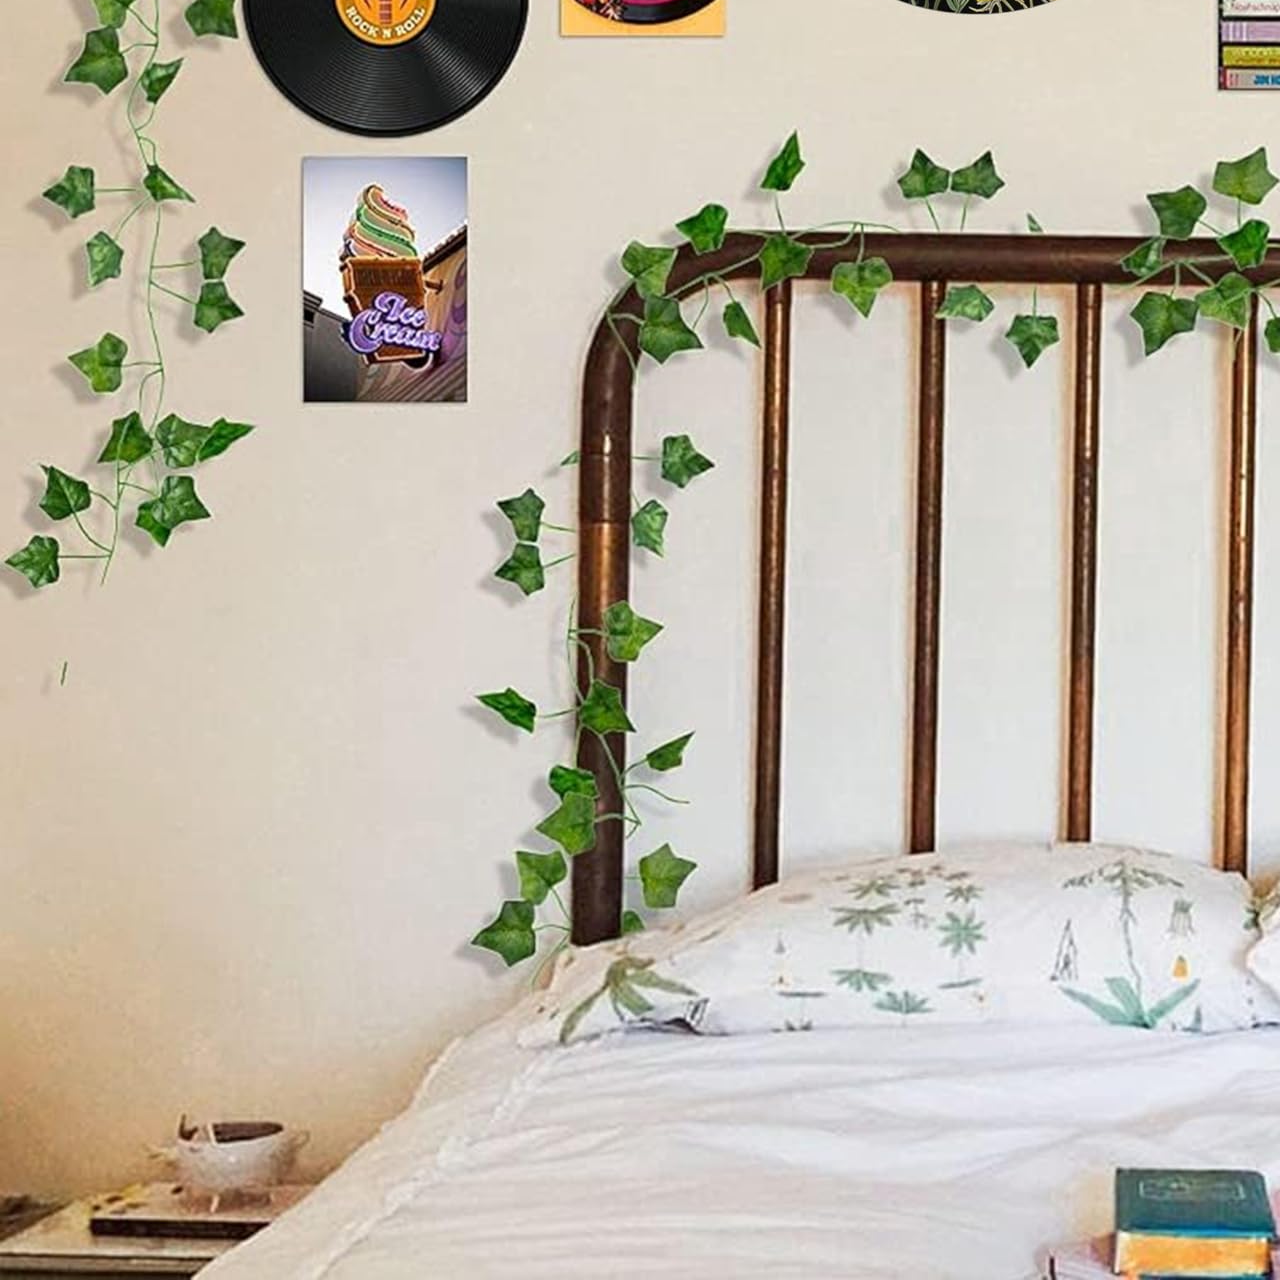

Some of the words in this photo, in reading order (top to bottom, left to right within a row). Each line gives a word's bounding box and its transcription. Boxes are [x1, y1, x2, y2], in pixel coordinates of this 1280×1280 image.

[345, 5, 380, 38] ROCK
[381, 28, 392, 38] N
[394, 7, 426, 36] ROLL
[374, 292, 426, 327] Ice
[349, 309, 442, 352] Cream
